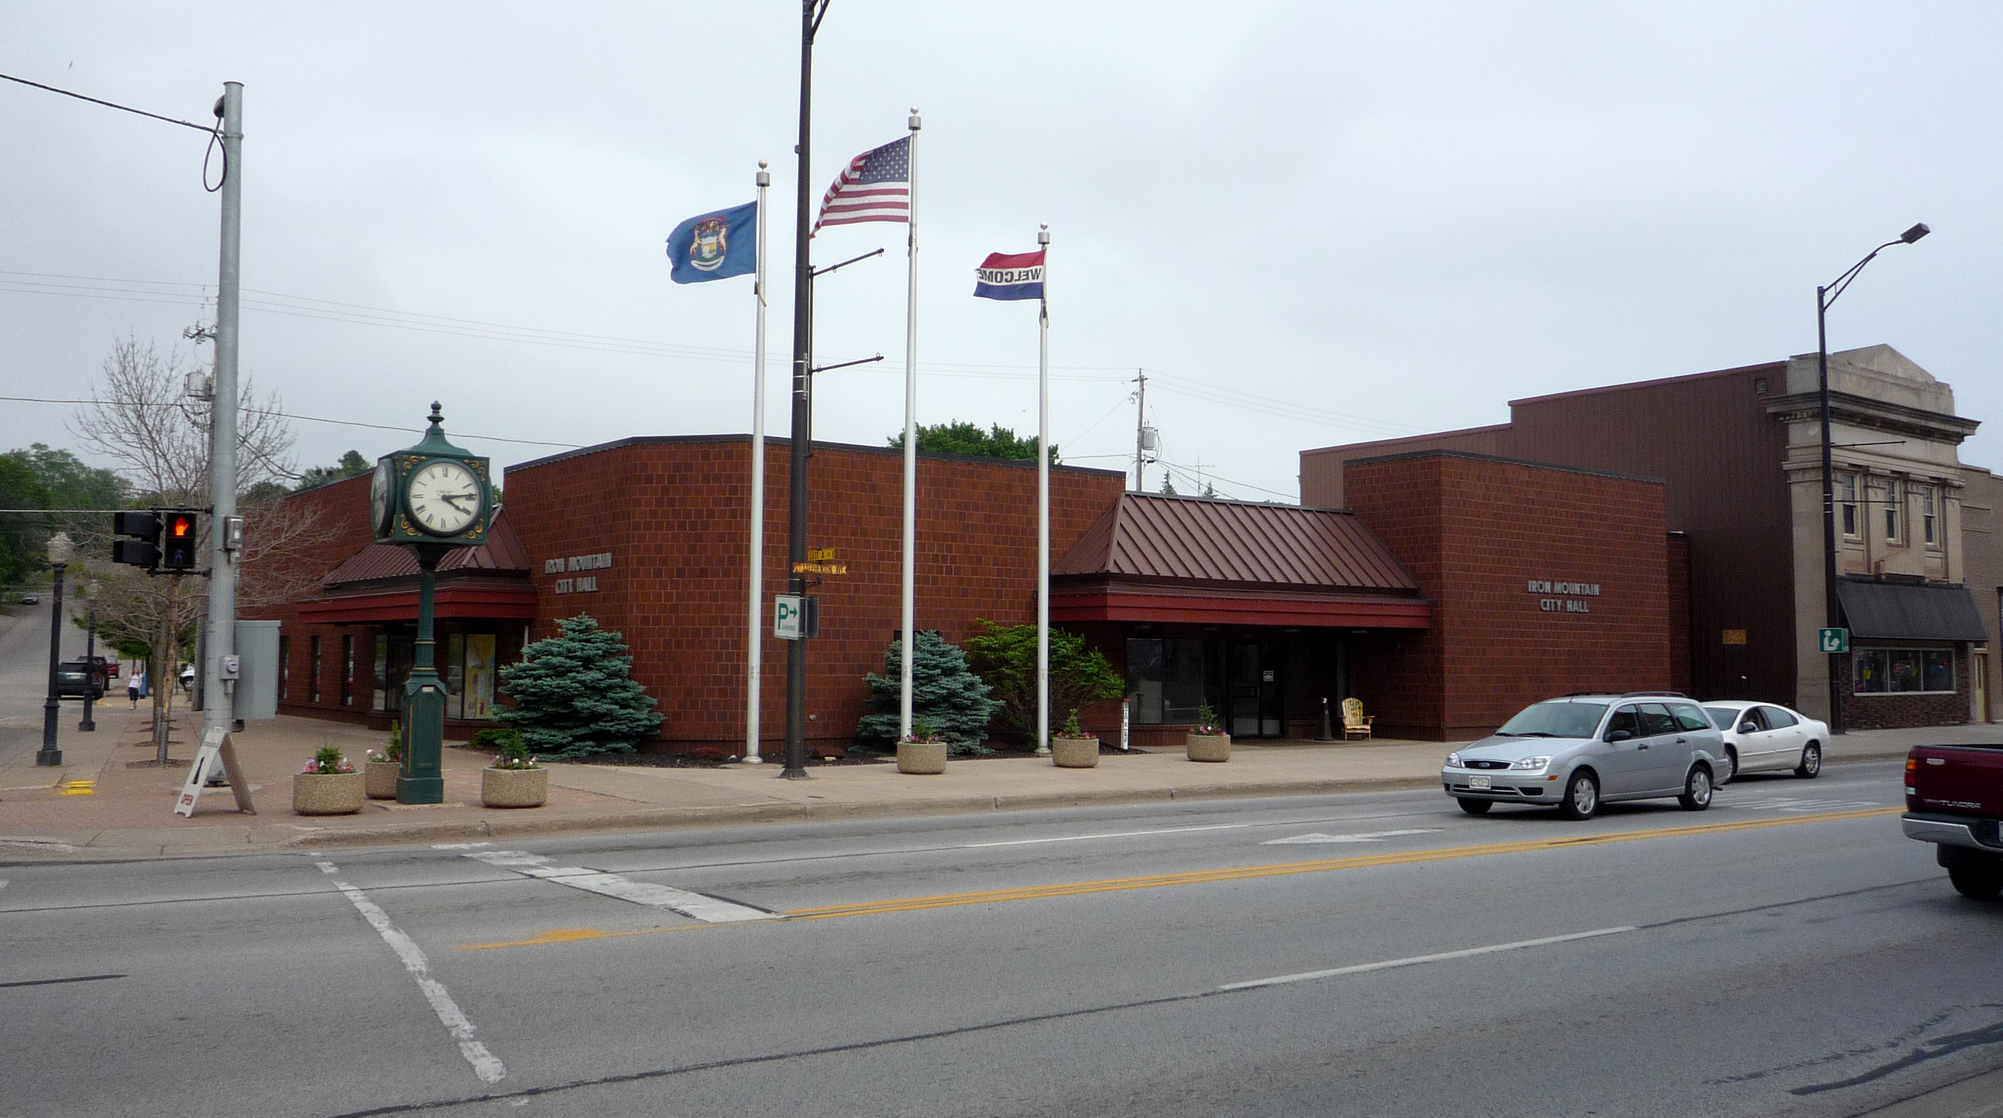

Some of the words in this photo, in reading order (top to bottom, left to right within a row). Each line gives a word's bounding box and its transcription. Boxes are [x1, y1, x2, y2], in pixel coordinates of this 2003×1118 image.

[568, 553, 611, 571] MOUNTAIN
[555, 579, 573, 594] CITY
[576, 577, 598, 592] HALL
[1528, 580, 1551, 593] IRON
[1554, 582, 1600, 596] MOUNTAIN
[1540, 599, 1561, 611] CITY
[1566, 600, 1589, 612] HALL
[1941, 800, 1981, 808] TUNDRA
